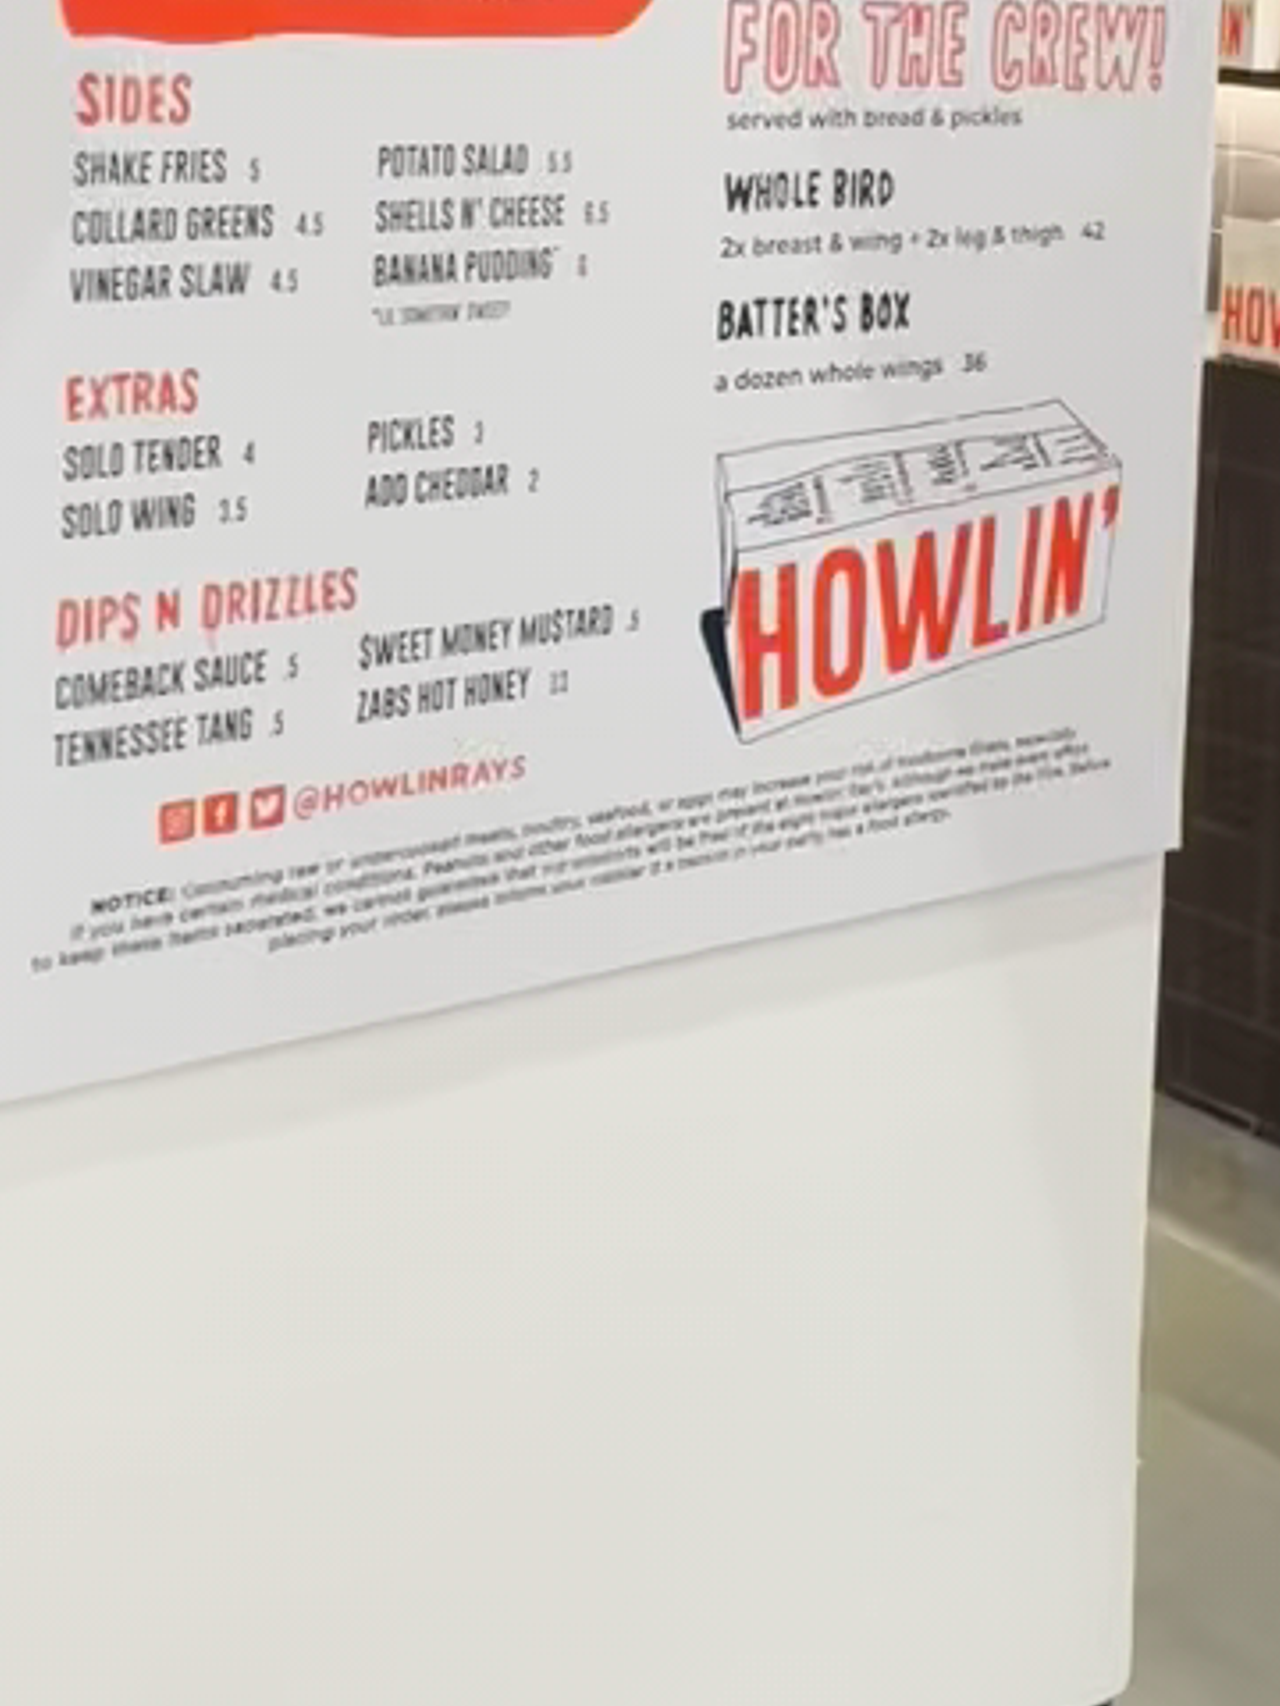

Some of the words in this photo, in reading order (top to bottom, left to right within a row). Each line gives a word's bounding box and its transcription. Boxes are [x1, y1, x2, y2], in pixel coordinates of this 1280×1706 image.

[861, 0, 970, 89] THE
[75, 71, 193, 126] SIDES
[726, 106, 803, 131] served
[808, 105, 858, 129] with
[862, 106, 925, 129] bread
[930, 108, 945, 128] &
[950, 105, 1024, 133] pickles
[72, 150, 153, 188] SHAKE
[160, 148, 228, 185] FRIES
[377, 143, 457, 178] POTATO
[462, 143, 529, 176] SALAD
[723, 169, 821, 214] WHOLE
[832, 167, 895, 210] BIRD
[71, 206, 179, 246] COLLARD
[185, 204, 275, 241] GREENS
[295, 210, 325, 236] 4.5
[375, 197, 454, 234] SHELLS
[489, 194, 566, 229] CHEESE
[720, 235, 747, 260] 2x
[751, 233, 822, 258] breast
[829, 231, 843, 253] &
[849, 228, 903, 257] wing
[925, 228, 950, 250] 2x
[955, 225, 986, 254] leg
[1011, 222, 1065, 248] thigh
[1080, 220, 1107, 242] 42
[70, 264, 172, 303] VINEGAR
[179, 261, 252, 298] SLAW
[270, 268, 299, 294] 4.5
[373, 252, 457, 288] BANANA
[716, 294, 848, 342] BATTER'S
[859, 290, 911, 333] BOX
[714, 374, 729, 392] a
[734, 362, 803, 391] dozen
[808, 357, 875, 387] whole
[882, 352, 945, 383] wings
[961, 351, 989, 374] 36
[65, 368, 200, 422] EXTRAS
[367, 415, 455, 454] PICKLES
[62, 442, 124, 482] SOLO
[132, 435, 222, 474] TENDER
[243, 442, 255, 465] 4
[364, 473, 408, 509] ADD
[414, 464, 510, 504] CHEDDAR
[61, 501, 123, 539] SOLO
[131, 494, 196, 532] WING
[56, 592, 140, 650] DIPS
[155, 590, 180, 633] N
[200, 567, 359, 632] DRIZZLES
[737, 484, 1119, 720] HOWLIN'
[440, 616, 513, 660] MONEY
[54, 660, 185, 711] COMEBACK
[193, 650, 267, 692] SAUCE
[356, 684, 412, 725] ZABS
[418, 677, 456, 715] HOT
[463, 667, 531, 708] HONEY
[54, 715, 188, 769] TENNESSEE
[196, 708, 252, 748] TANG
[293, 755, 526, 821] @HOWLINRAYS
[91, 886, 174, 916] NOTICE:
